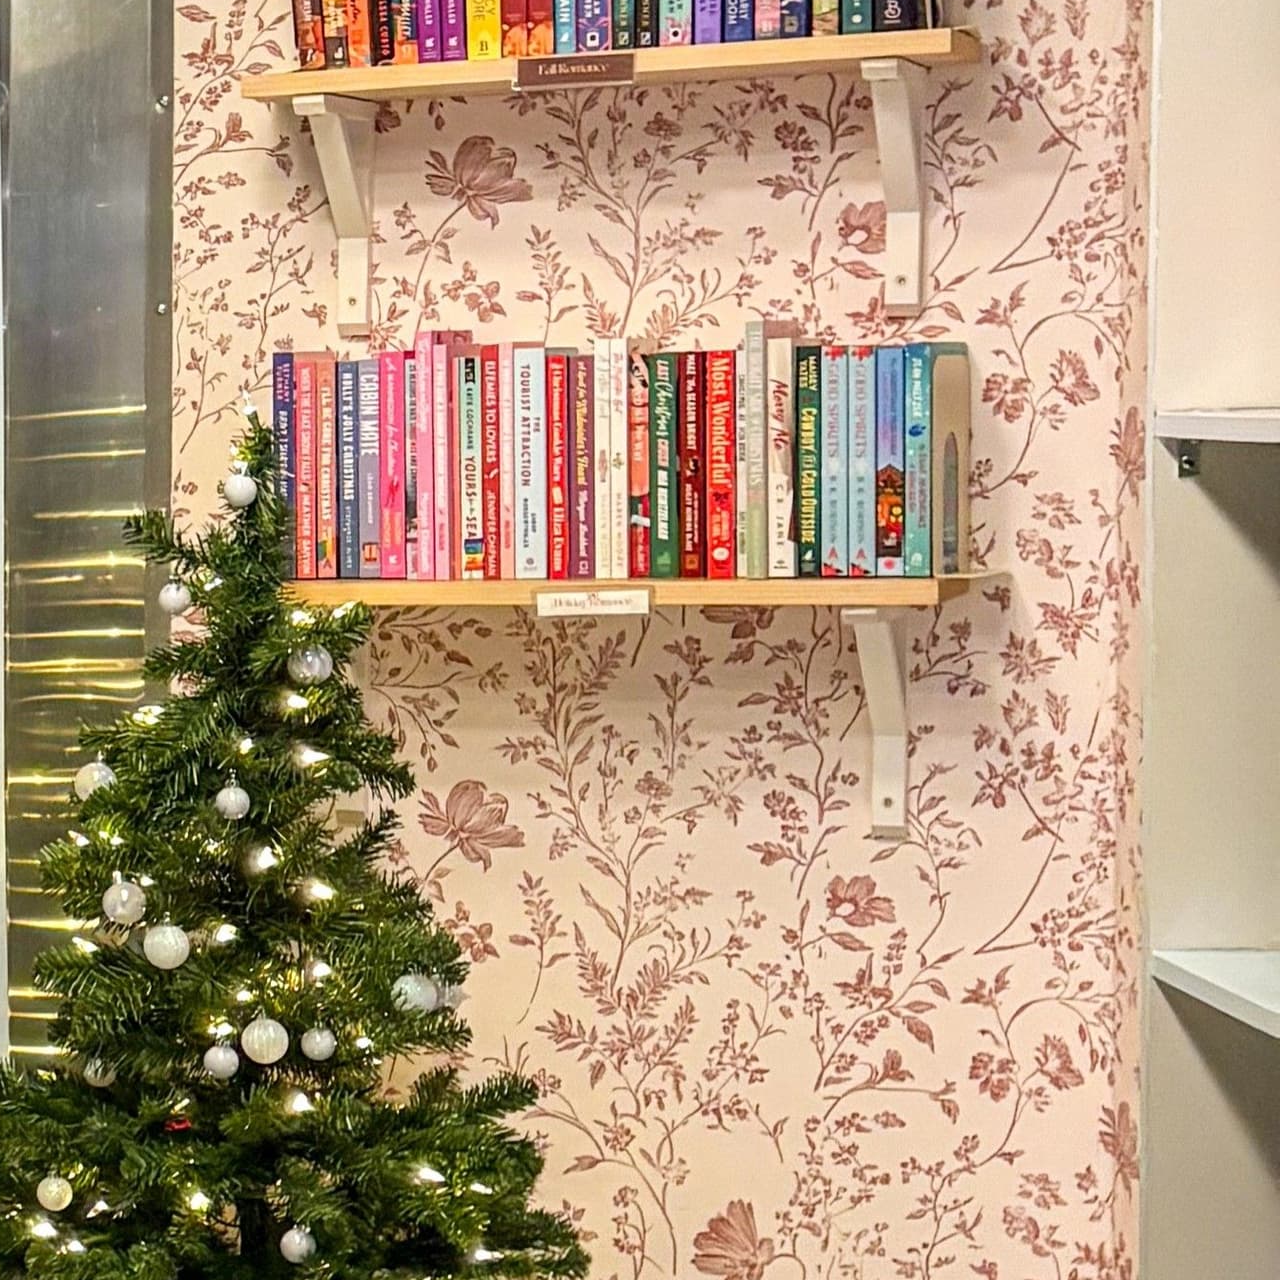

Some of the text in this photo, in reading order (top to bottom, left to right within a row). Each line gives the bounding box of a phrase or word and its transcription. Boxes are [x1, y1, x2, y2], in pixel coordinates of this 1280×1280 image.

[770, 380, 790, 423] Merry
[799, 359, 809, 388] YATES
[360, 373, 379, 457] CABIN MATE
[487, 409, 497, 422] TO
[521, 364, 531, 486] TOURIST ATTRACTION
[712, 402, 732, 485] Wonderful
[827, 364, 841, 458] GOOD SPIRITS
[855, 364, 869, 459] GOOD SPIRITS
[343, 445, 355, 501] CHRISTMAS
[465, 456, 477, 497] YOURS
[802, 470, 817, 544] COLD OUTSIDE
